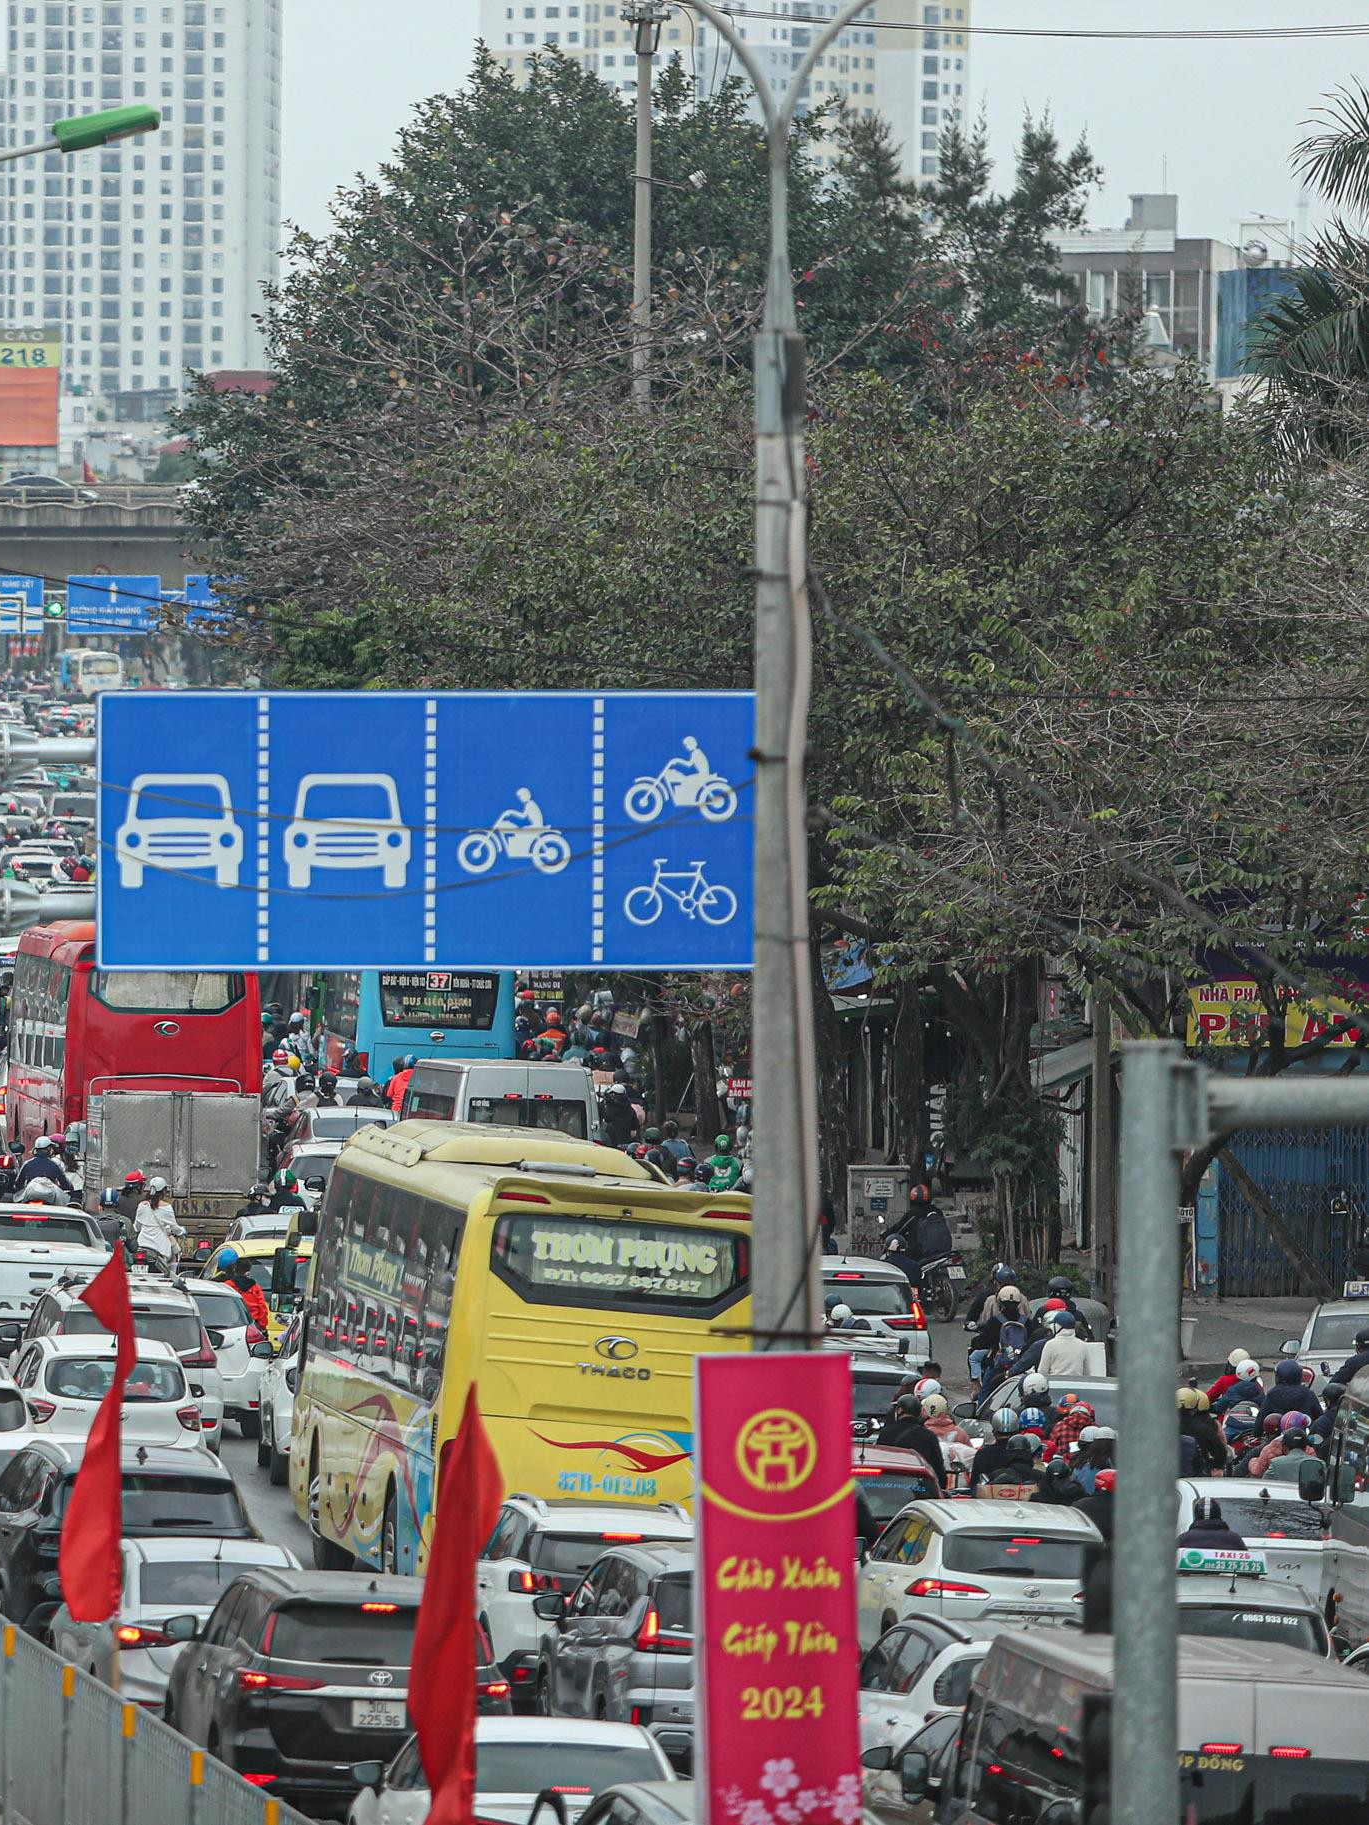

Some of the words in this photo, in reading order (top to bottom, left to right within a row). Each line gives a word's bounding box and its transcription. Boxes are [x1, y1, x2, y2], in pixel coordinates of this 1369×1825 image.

[1, 347, 47, 365] 218
[429, 975, 449, 988] 37
[1198, 985, 1229, 1002] NHÀ
[531, 1230, 615, 1266] THƠM
[617, 1237, 719, 1277] PHỤNG
[576, 1361, 652, 1381] THACO
[557, 1470, 657, 1497] 37B-012.03
[1214, 1551, 1237, 1559] TAXI
[716, 1555, 776, 1593] Chào
[780, 1554, 842, 1591] Xuân
[721, 1621, 778, 1665] Giáp
[783, 1619, 838, 1656] Thìn
[740, 1685, 825, 1721] 2024
[358, 1713, 401, 1727] 225.96
[1197, 1753, 1245, 1772] ĐỒNG
